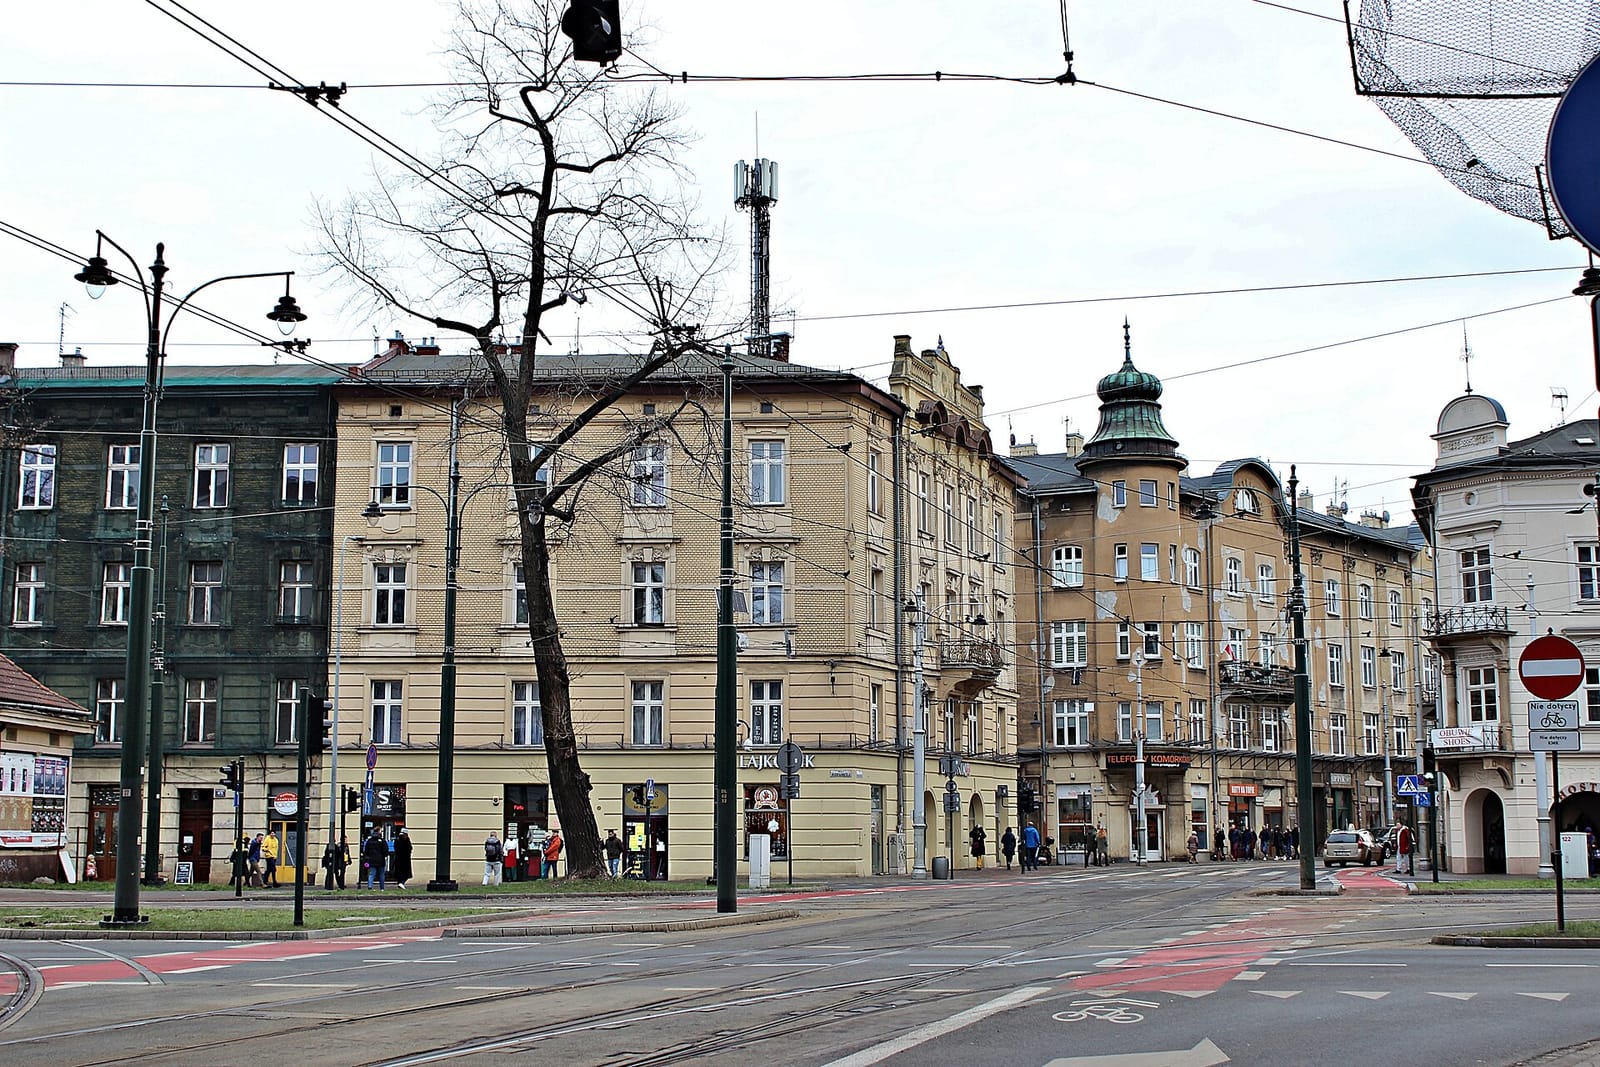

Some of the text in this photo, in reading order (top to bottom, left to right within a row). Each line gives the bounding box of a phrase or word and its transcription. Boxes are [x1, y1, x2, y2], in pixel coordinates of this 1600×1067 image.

[1546, 703, 1576, 711] dotyczy
[1443, 738, 1471, 746] SHOES
[739, 754, 815, 770] LAJKIK
[1106, 755, 1150, 764] TELEFOY
